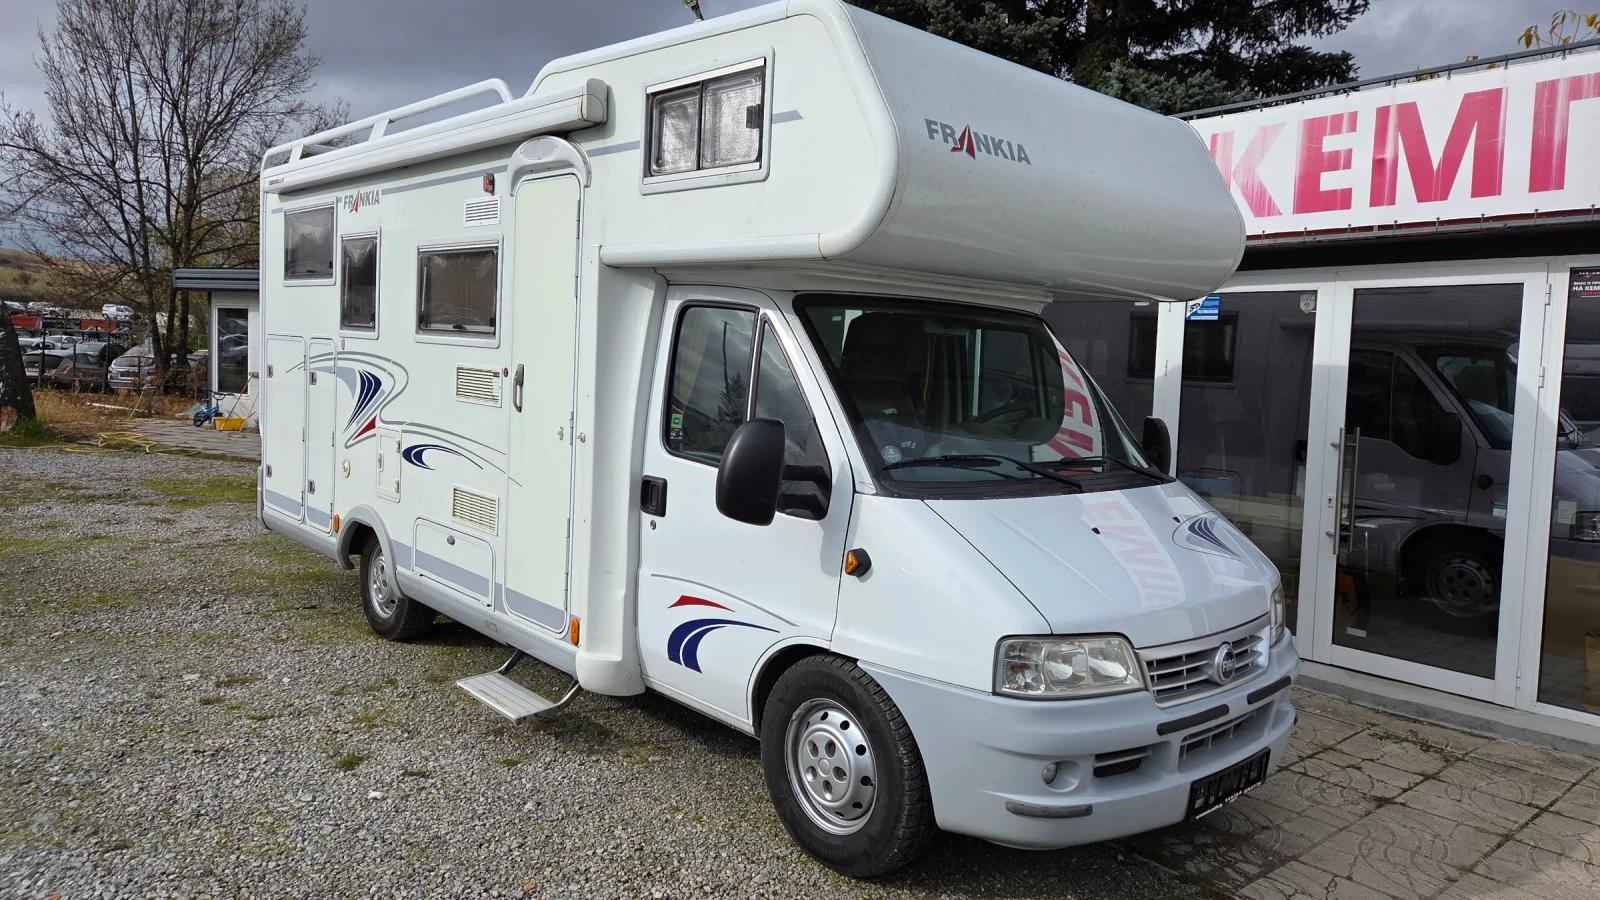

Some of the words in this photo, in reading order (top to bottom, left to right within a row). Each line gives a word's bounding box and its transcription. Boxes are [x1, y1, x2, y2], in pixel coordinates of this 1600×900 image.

[924, 118, 1032, 166] FRANKIA
[343, 188, 380, 213] FRANKIA
[1222, 658, 1236, 672] FIAT
